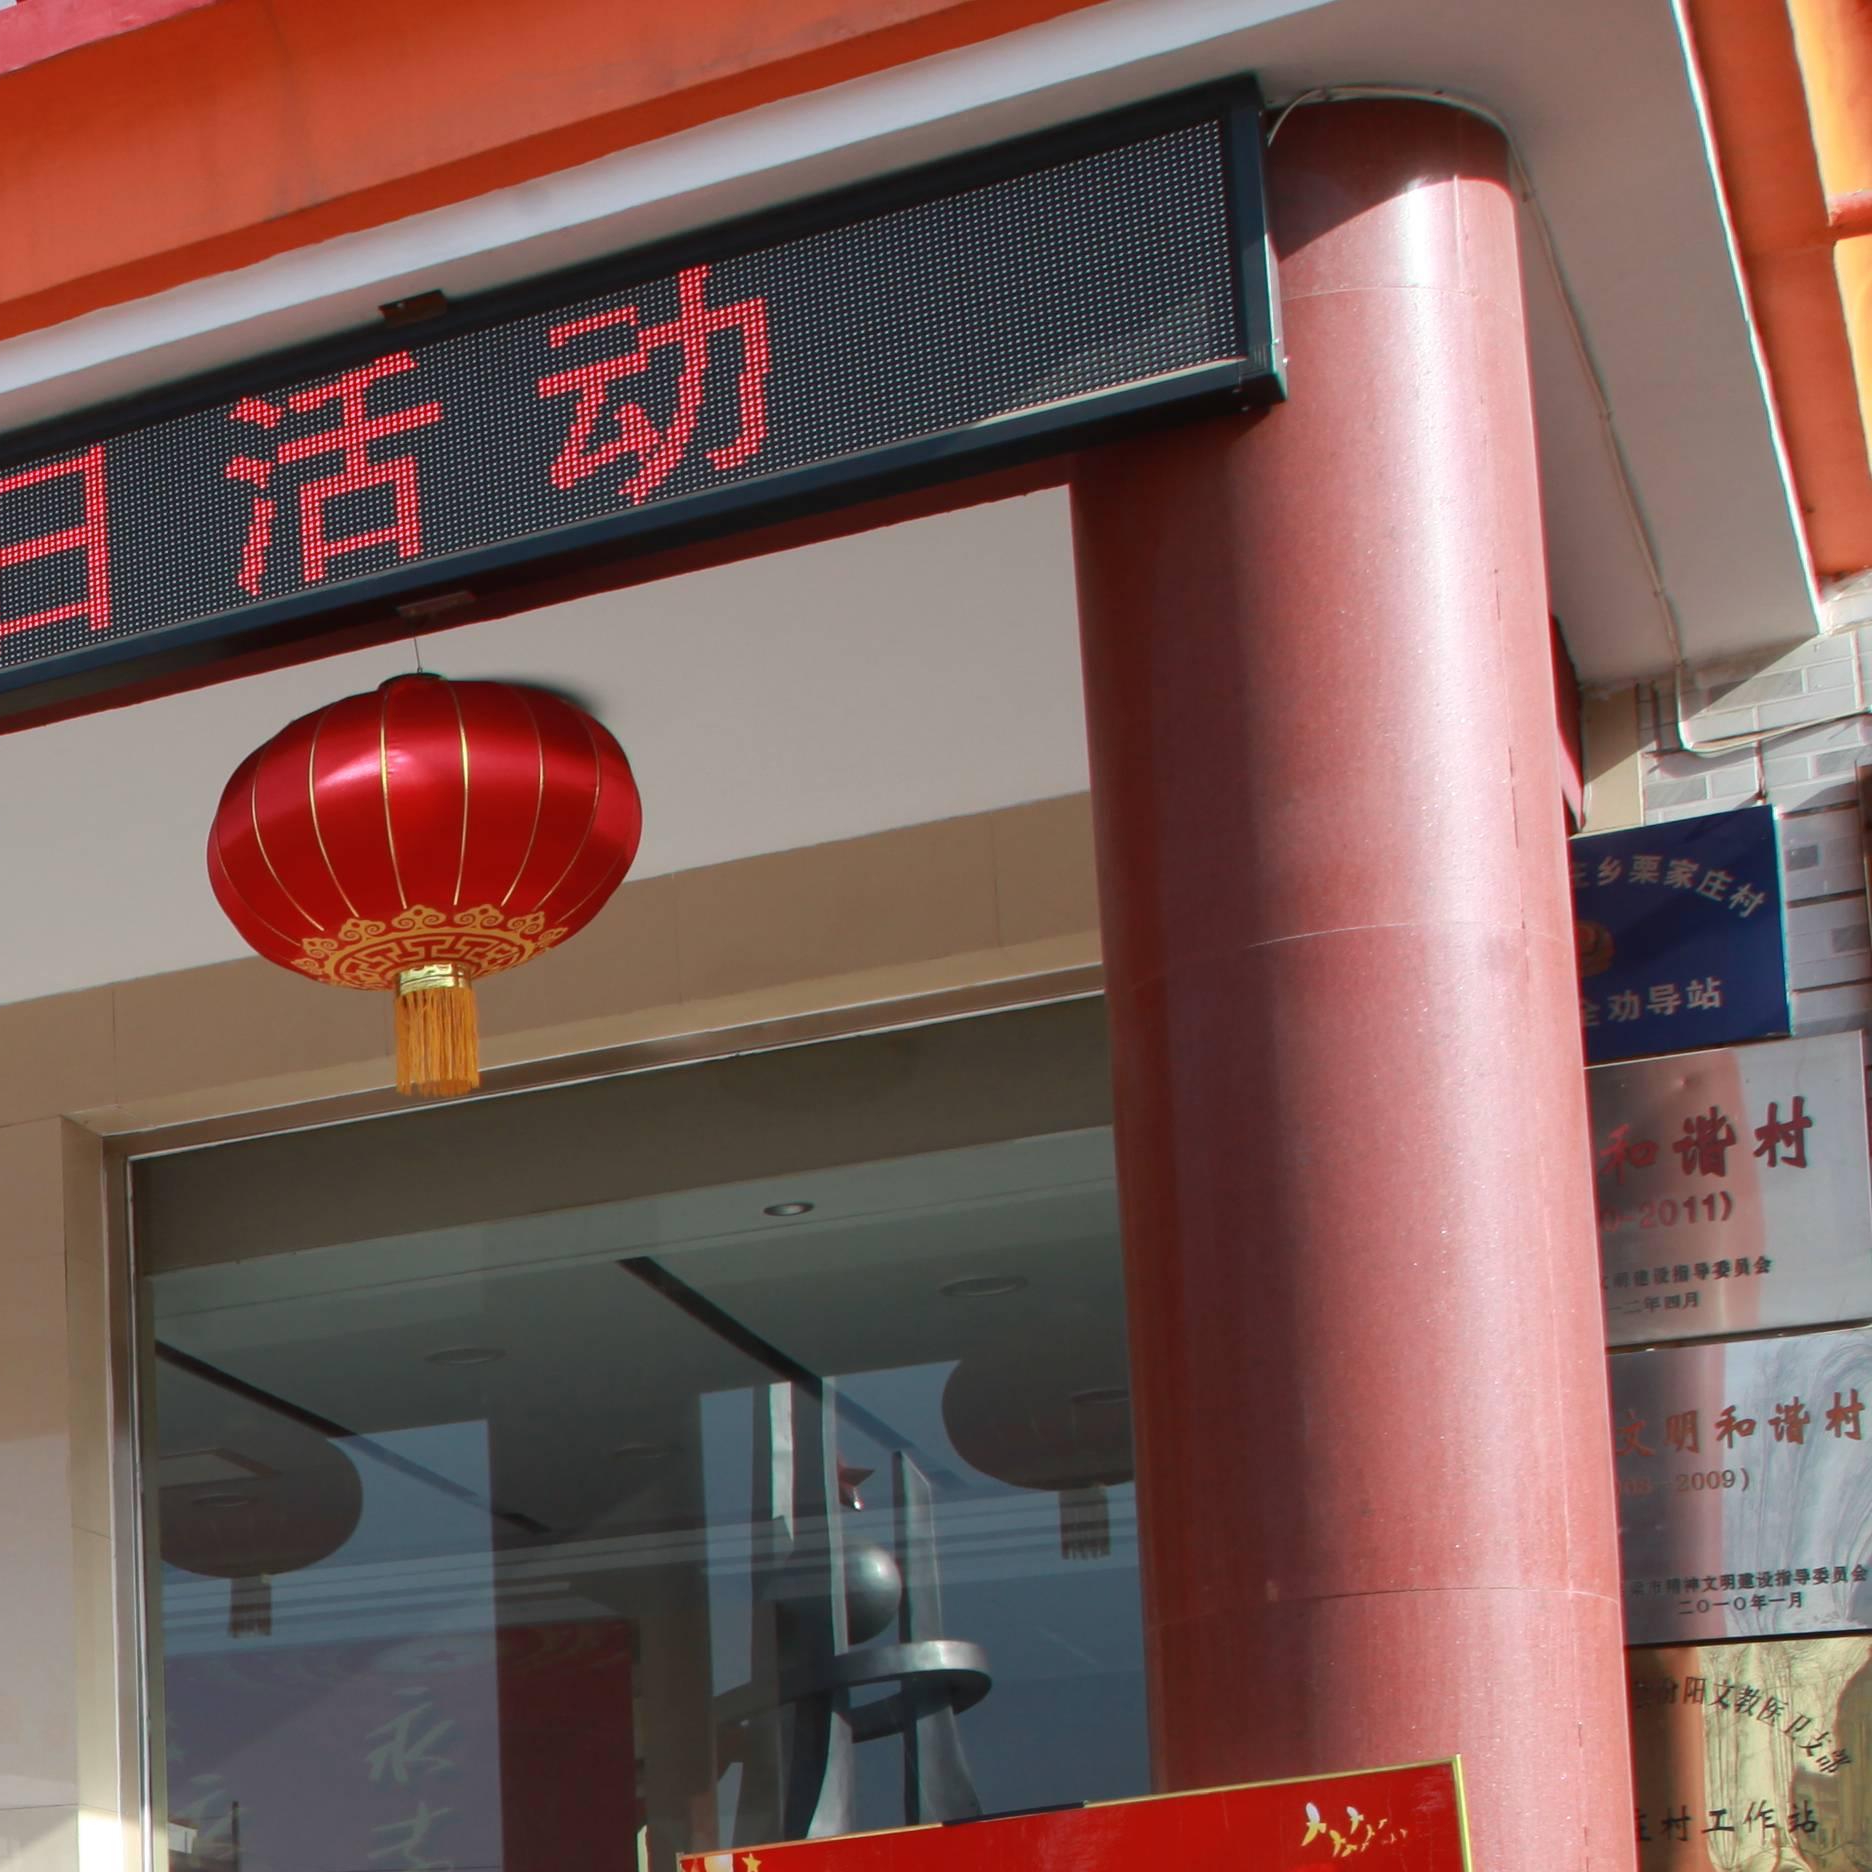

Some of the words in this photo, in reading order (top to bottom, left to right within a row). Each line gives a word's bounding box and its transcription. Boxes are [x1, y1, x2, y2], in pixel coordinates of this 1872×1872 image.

[1600, 1096, 1812, 1185] 和谐村
[1602, 1256, 1772, 1289] 明建设指导委员会
[1616, 1388, 1865, 1456] 文明和谐村
